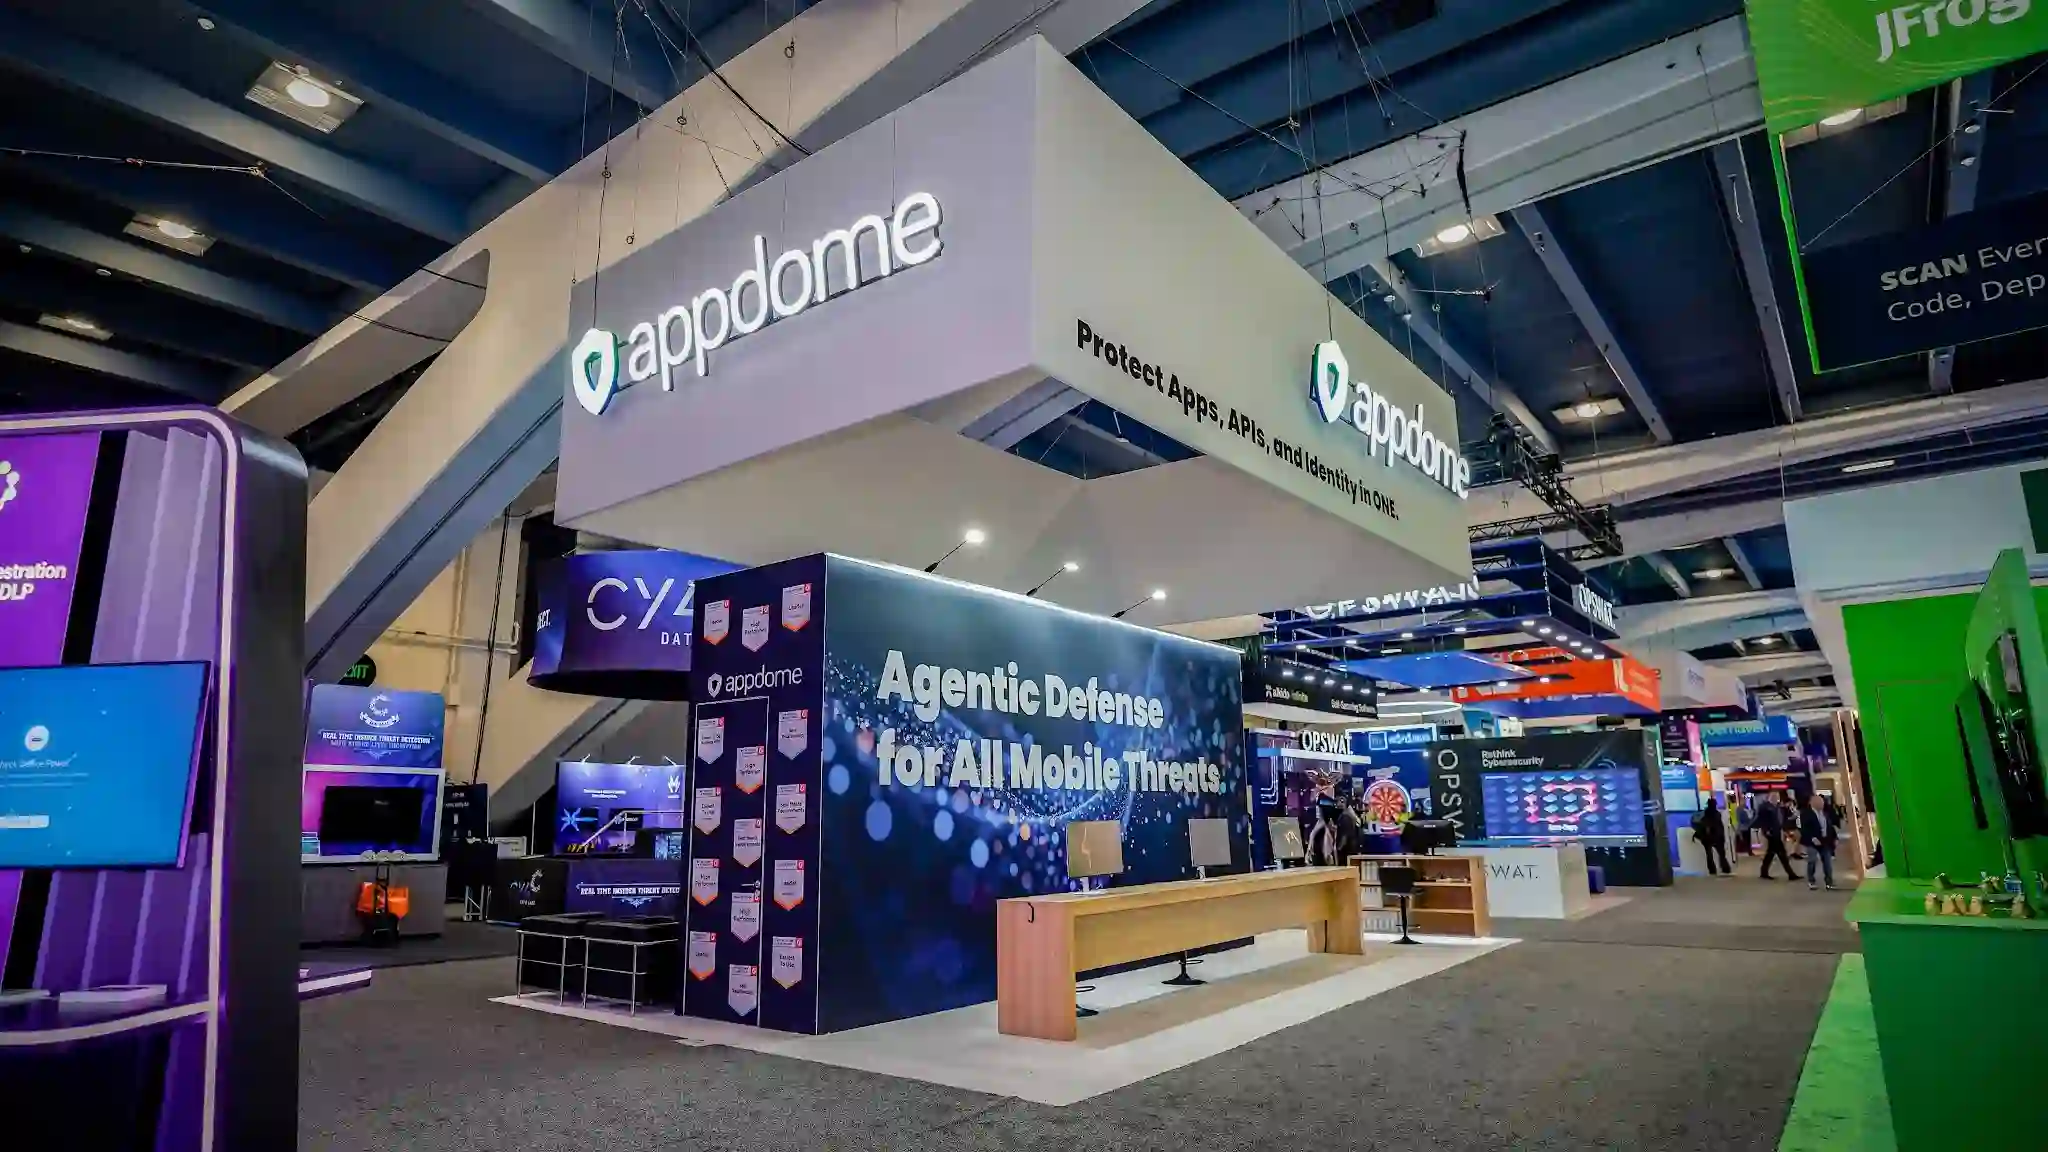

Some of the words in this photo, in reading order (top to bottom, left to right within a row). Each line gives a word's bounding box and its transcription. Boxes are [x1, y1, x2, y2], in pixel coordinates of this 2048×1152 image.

[628, 192, 943, 391] appdome
[1880, 253, 1969, 291] SCAN
[1887, 292, 1971, 321] Code,
[1981, 274, 2046, 302] Dep
[1077, 319, 1164, 394] Protect
[1168, 374, 1224, 429] Apps,
[1228, 408, 1270, 454] APIs,
[1274, 437, 1303, 469] and
[1305, 452, 1357, 504] Identity
[1359, 479, 1372, 506] in
[1373, 490, 1399, 520] ONE.
[1353, 383, 1471, 500] appdome
[725, 664, 803, 697] appdome
[876, 649, 1041, 723] Agentic
[1045, 674, 1165, 729] Defense
[876, 727, 943, 787] for
[950, 739, 1002, 788] All
[1011, 741, 1121, 791] Mobile
[1481, 749, 1517, 759] Rethink
[1482, 757, 1545, 769] Cybersecurity
